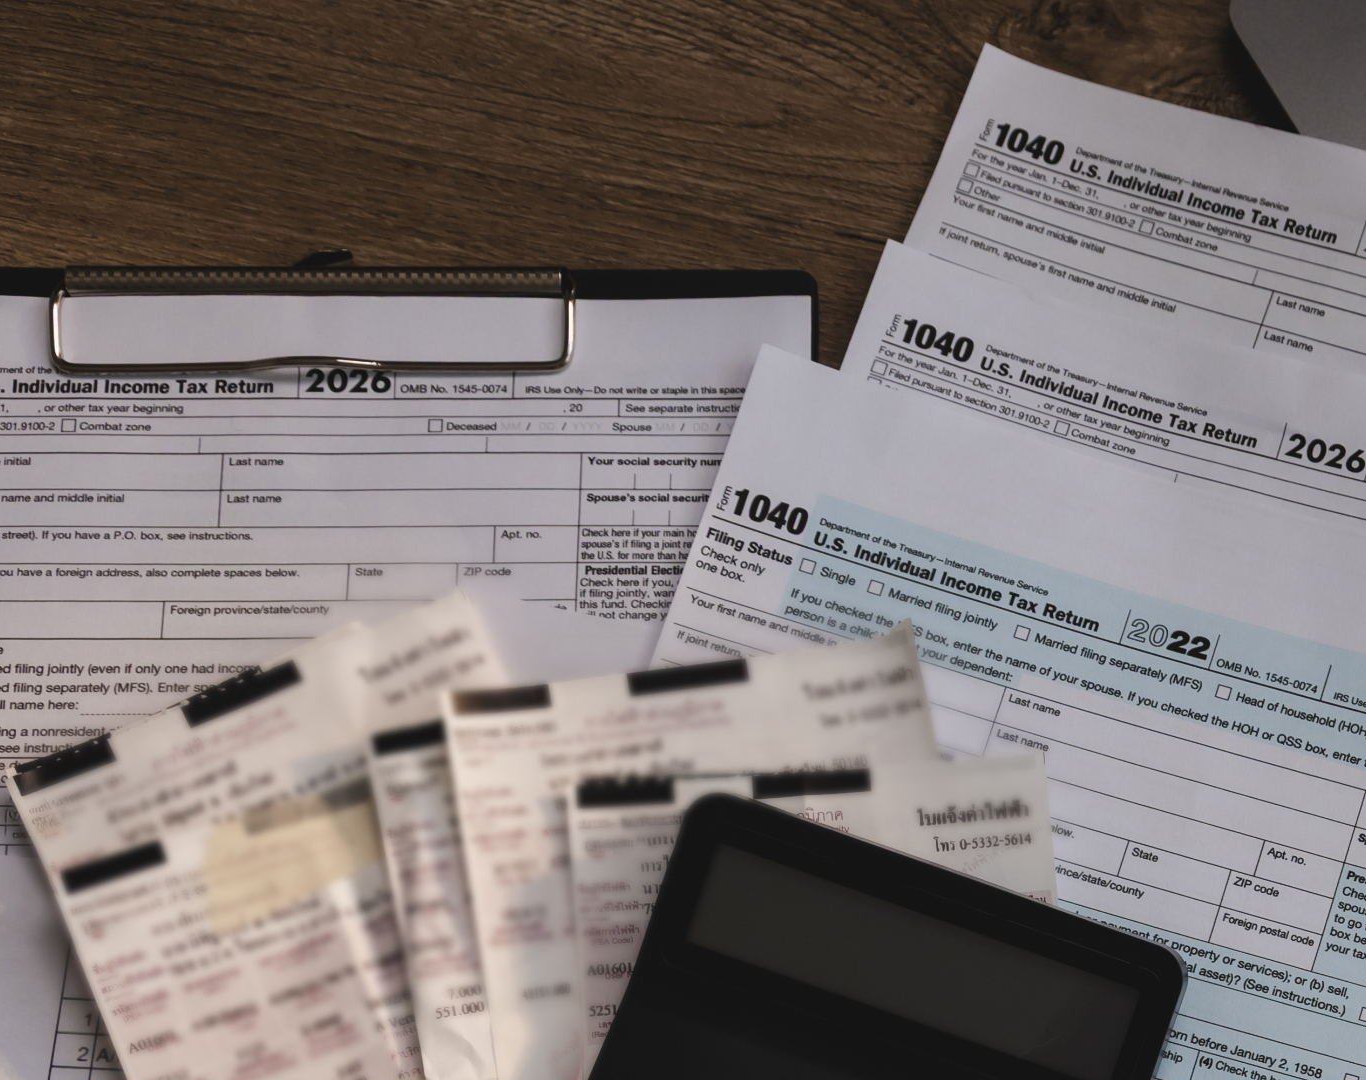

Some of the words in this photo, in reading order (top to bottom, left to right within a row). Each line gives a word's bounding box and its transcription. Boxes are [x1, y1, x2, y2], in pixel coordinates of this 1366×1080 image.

[995, 123, 1065, 166] 1040
[1275, 295, 1298, 310] Last
[1298, 303, 1326, 317] name
[902, 318, 975, 363] 1040
[12, 378, 98, 394] Individual
[104, 378, 170, 395] Income
[175, 378, 208, 394] Tax
[214, 379, 274, 394] Return
[306, 369, 392, 394] 2026
[400, 384, 428, 394] OMB
[430, 384, 448, 394] No.
[452, 384, 508, 394] 1545-0074
[0, 421, 56, 431] 301.9100-2
[1284, 433, 1366, 474] 2026
[733, 488, 809, 536] 1040
[705, 526, 745, 552] Filing
[747, 541, 793, 566] Status
[813, 530, 848, 555] U.S.
[853, 544, 937, 582] Individual
[939, 571, 1003, 602] Income
[1008, 591, 1039, 614] Tax
[1042, 602, 1100, 633] Return
[819, 566, 856, 586] Single
[1126, 618, 1211, 661] 2022
[1235, 691, 1266, 709] Head
[1266, 702, 1280, 712] of
[1279, 703, 1337, 729] household
[959, 832, 1032, 851] 0-5332-5614
[1232, 876, 1253, 889] ZIP
[1253, 884, 1280, 898] code
